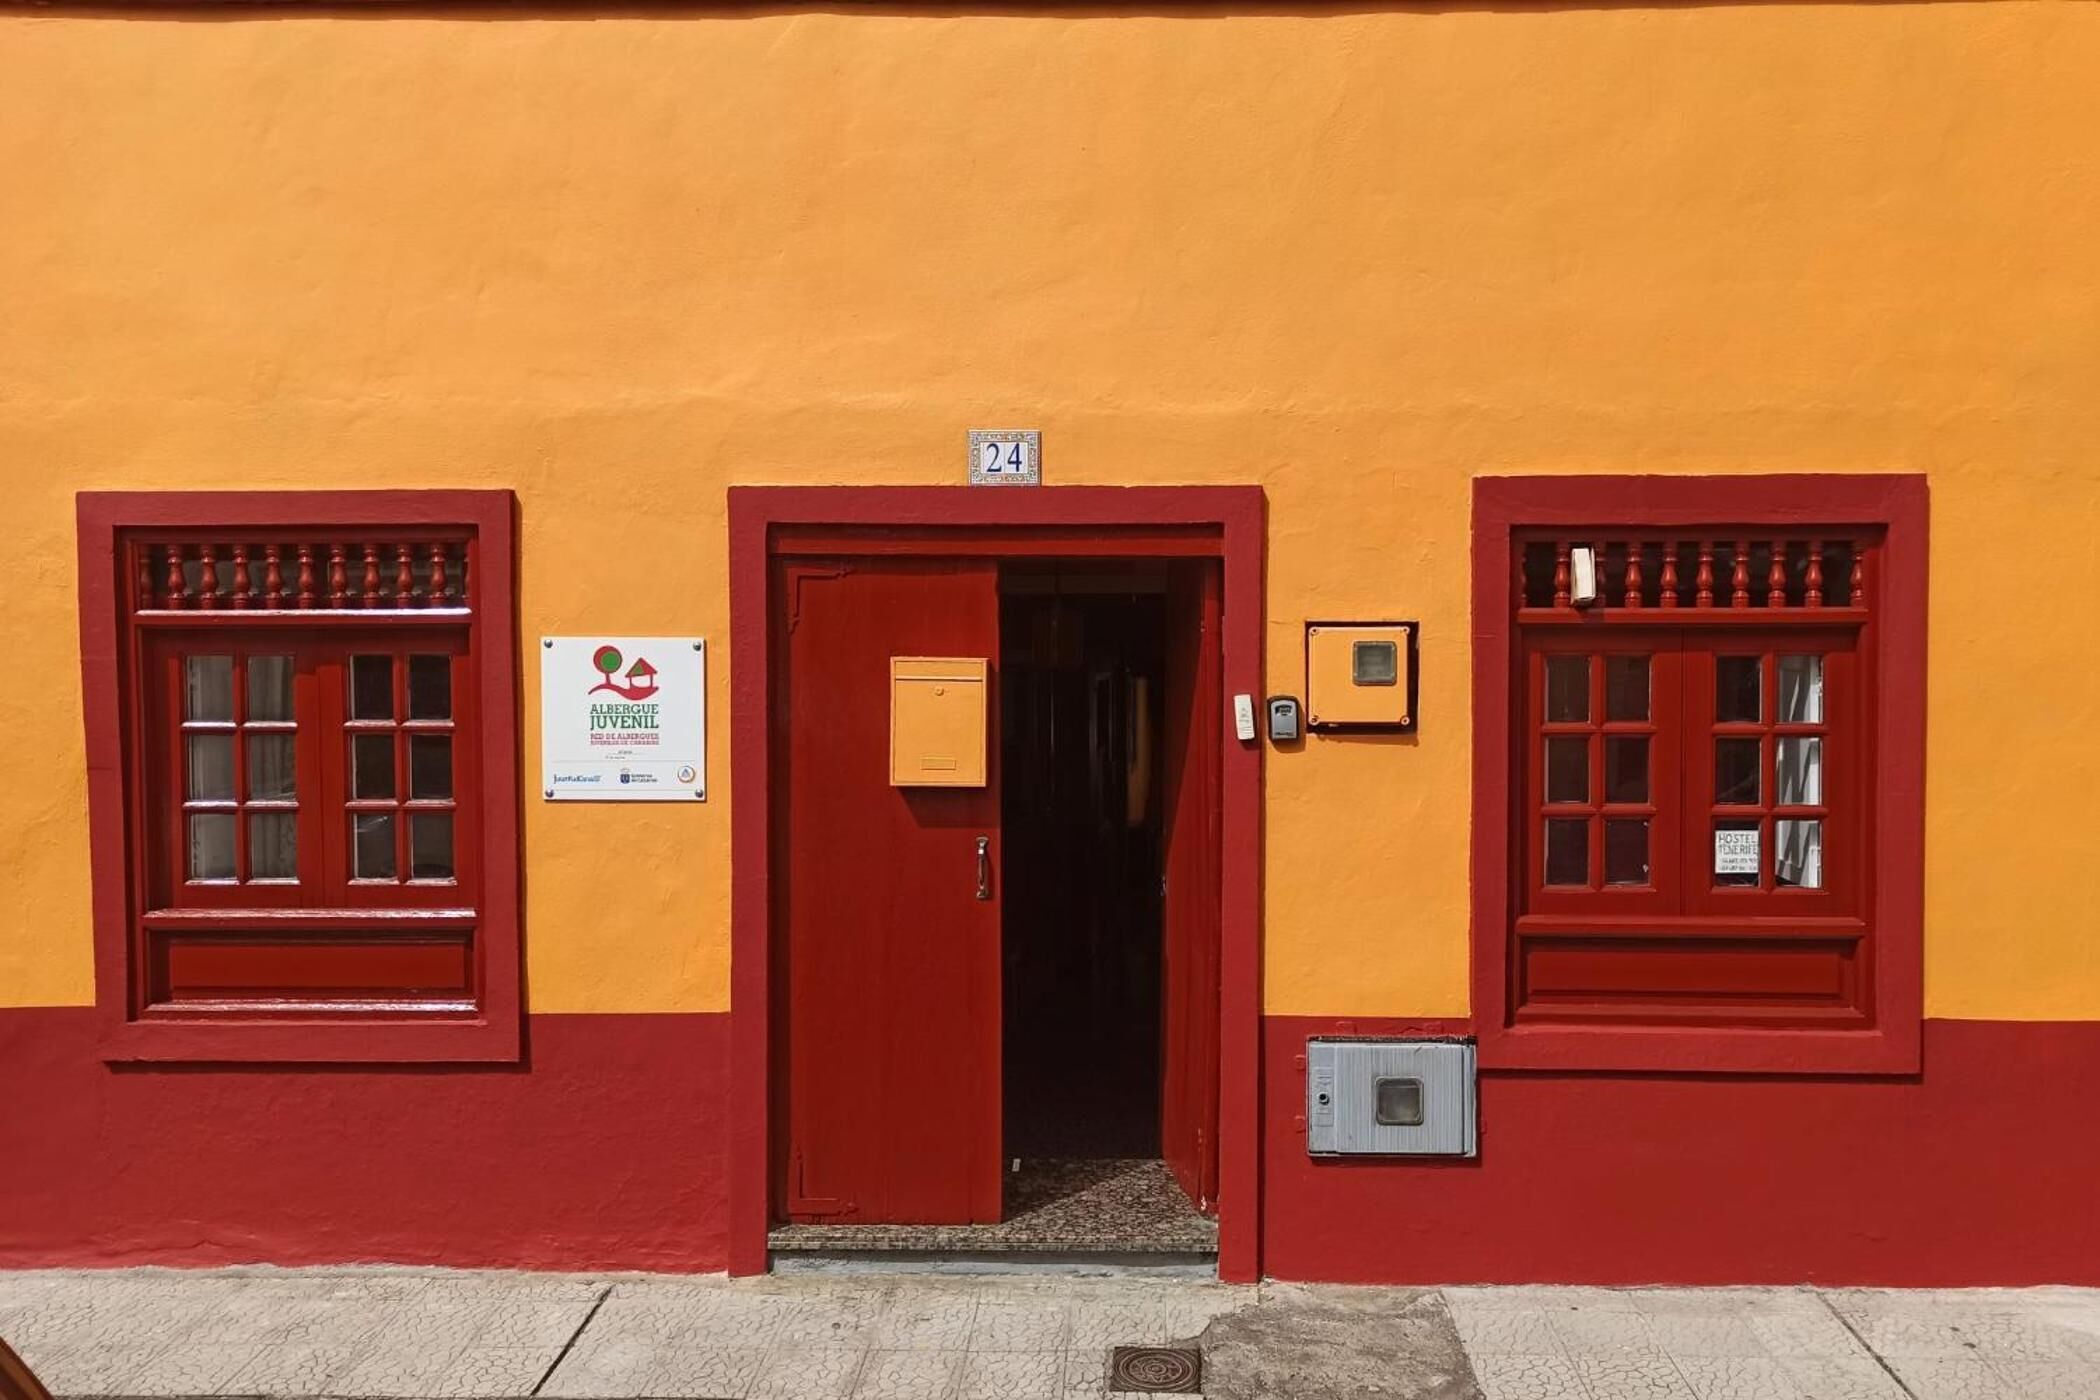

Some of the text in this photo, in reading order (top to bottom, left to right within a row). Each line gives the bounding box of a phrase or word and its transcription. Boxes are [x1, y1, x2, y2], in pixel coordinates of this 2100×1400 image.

[986, 442, 1023, 472] 24
[590, 703, 659, 714] ALBERGUE
[590, 715, 659, 731] JUVENIL
[1718, 833, 1757, 844] HOSTEL
[1718, 844, 1758, 855] TENERIFE
